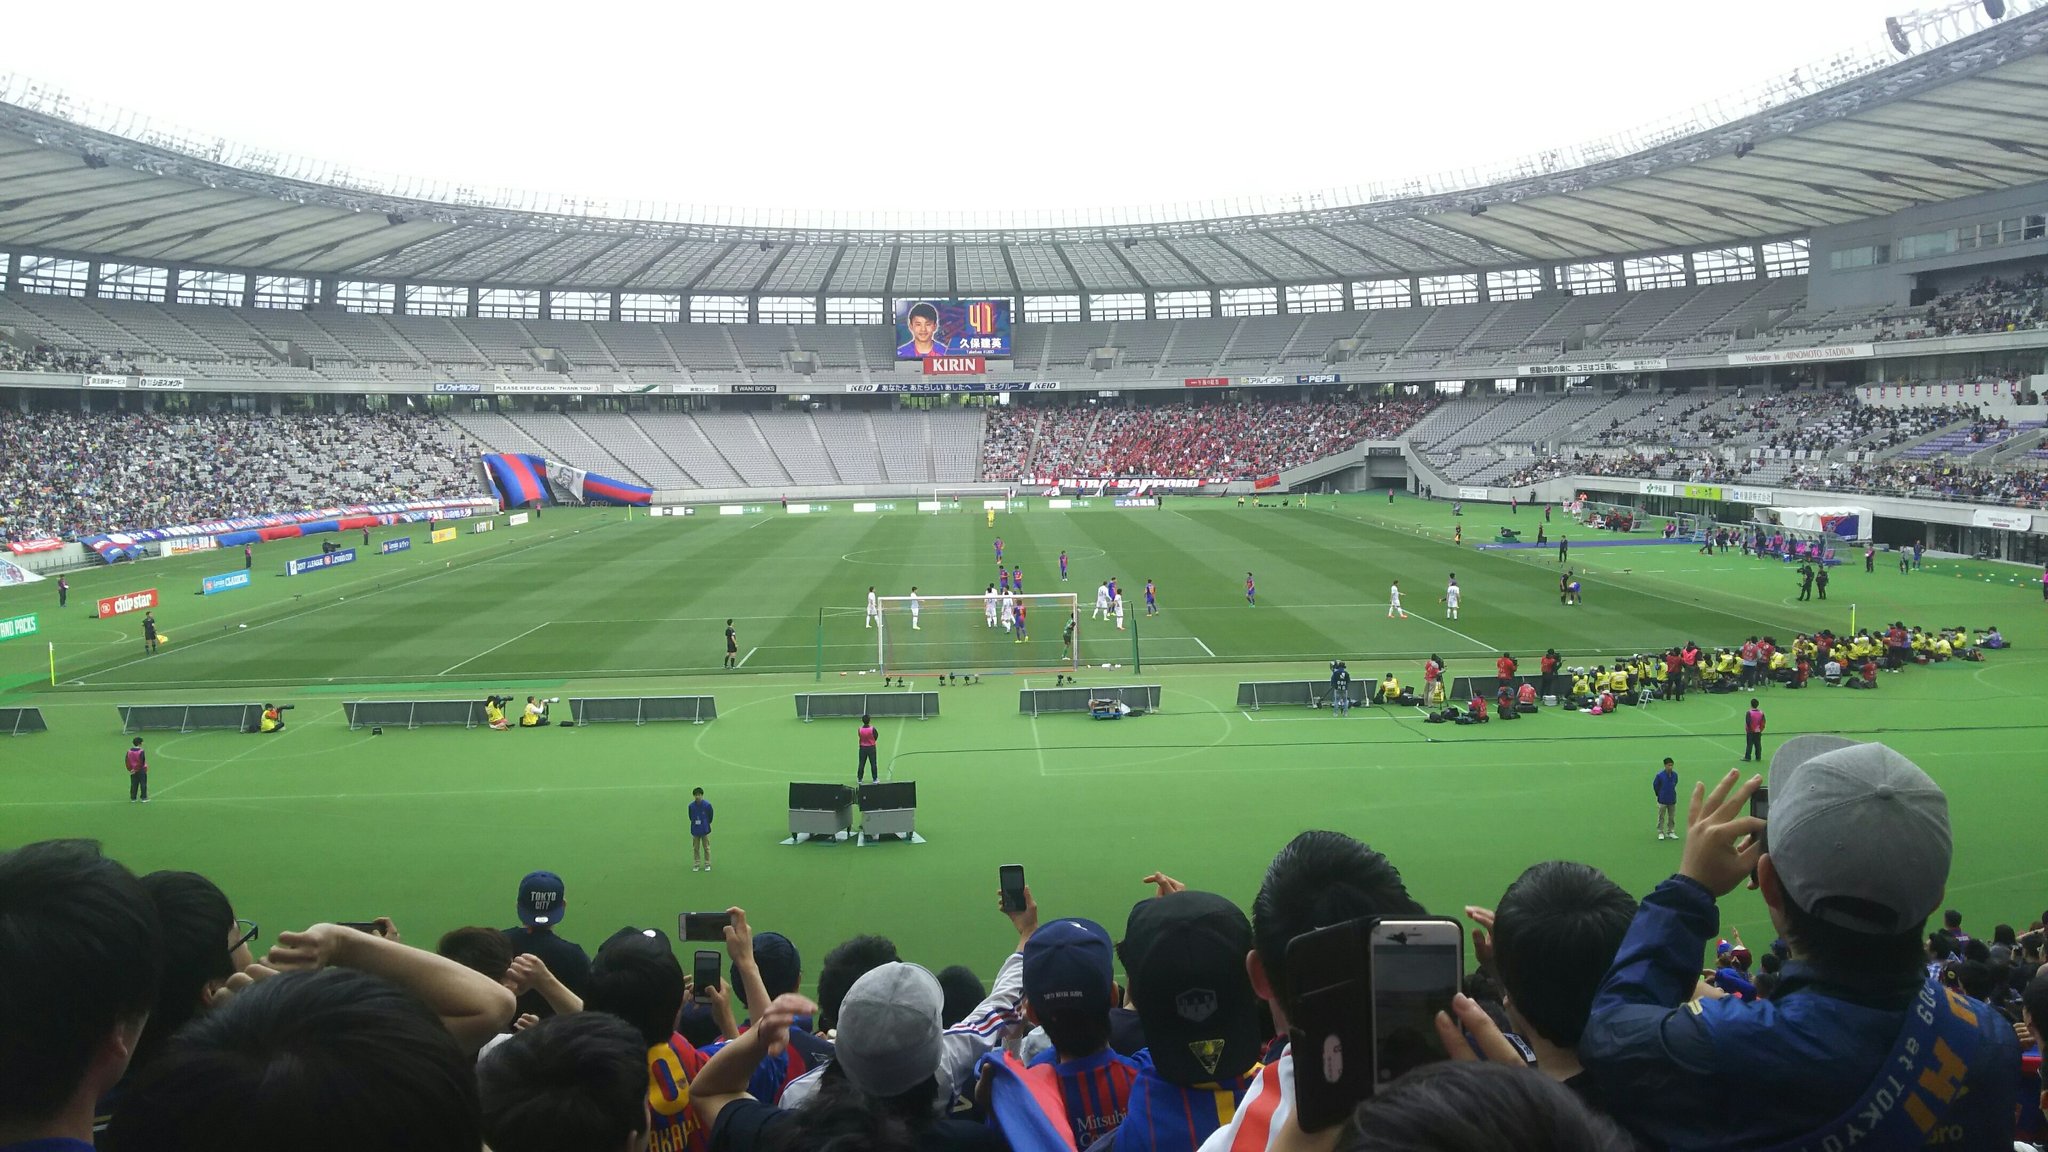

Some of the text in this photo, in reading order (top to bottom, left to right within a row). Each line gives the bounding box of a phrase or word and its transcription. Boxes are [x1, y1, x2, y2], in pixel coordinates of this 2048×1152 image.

[968, 302, 993, 333] 41
[960, 338, 1001, 348] 久保建英
[1785, 350, 1821, 360] AJINOMOTO
[1825, 347, 1855, 356] STADIUM
[933, 358, 976, 371] KIRIN
[1309, 375, 1335, 383] PEPSI
[850, 384, 873, 392] KEIO
[881, 384, 908, 392] あなたと
[945, 383, 971, 391] あしたへ
[1034, 382, 1056, 390] KEIO
[1117, 479, 1200, 488] SAPPORO
[15, 616, 36, 634] PACKS
[530, 891, 557, 901] TOKYO
[535, 901, 550, 910] CITY
